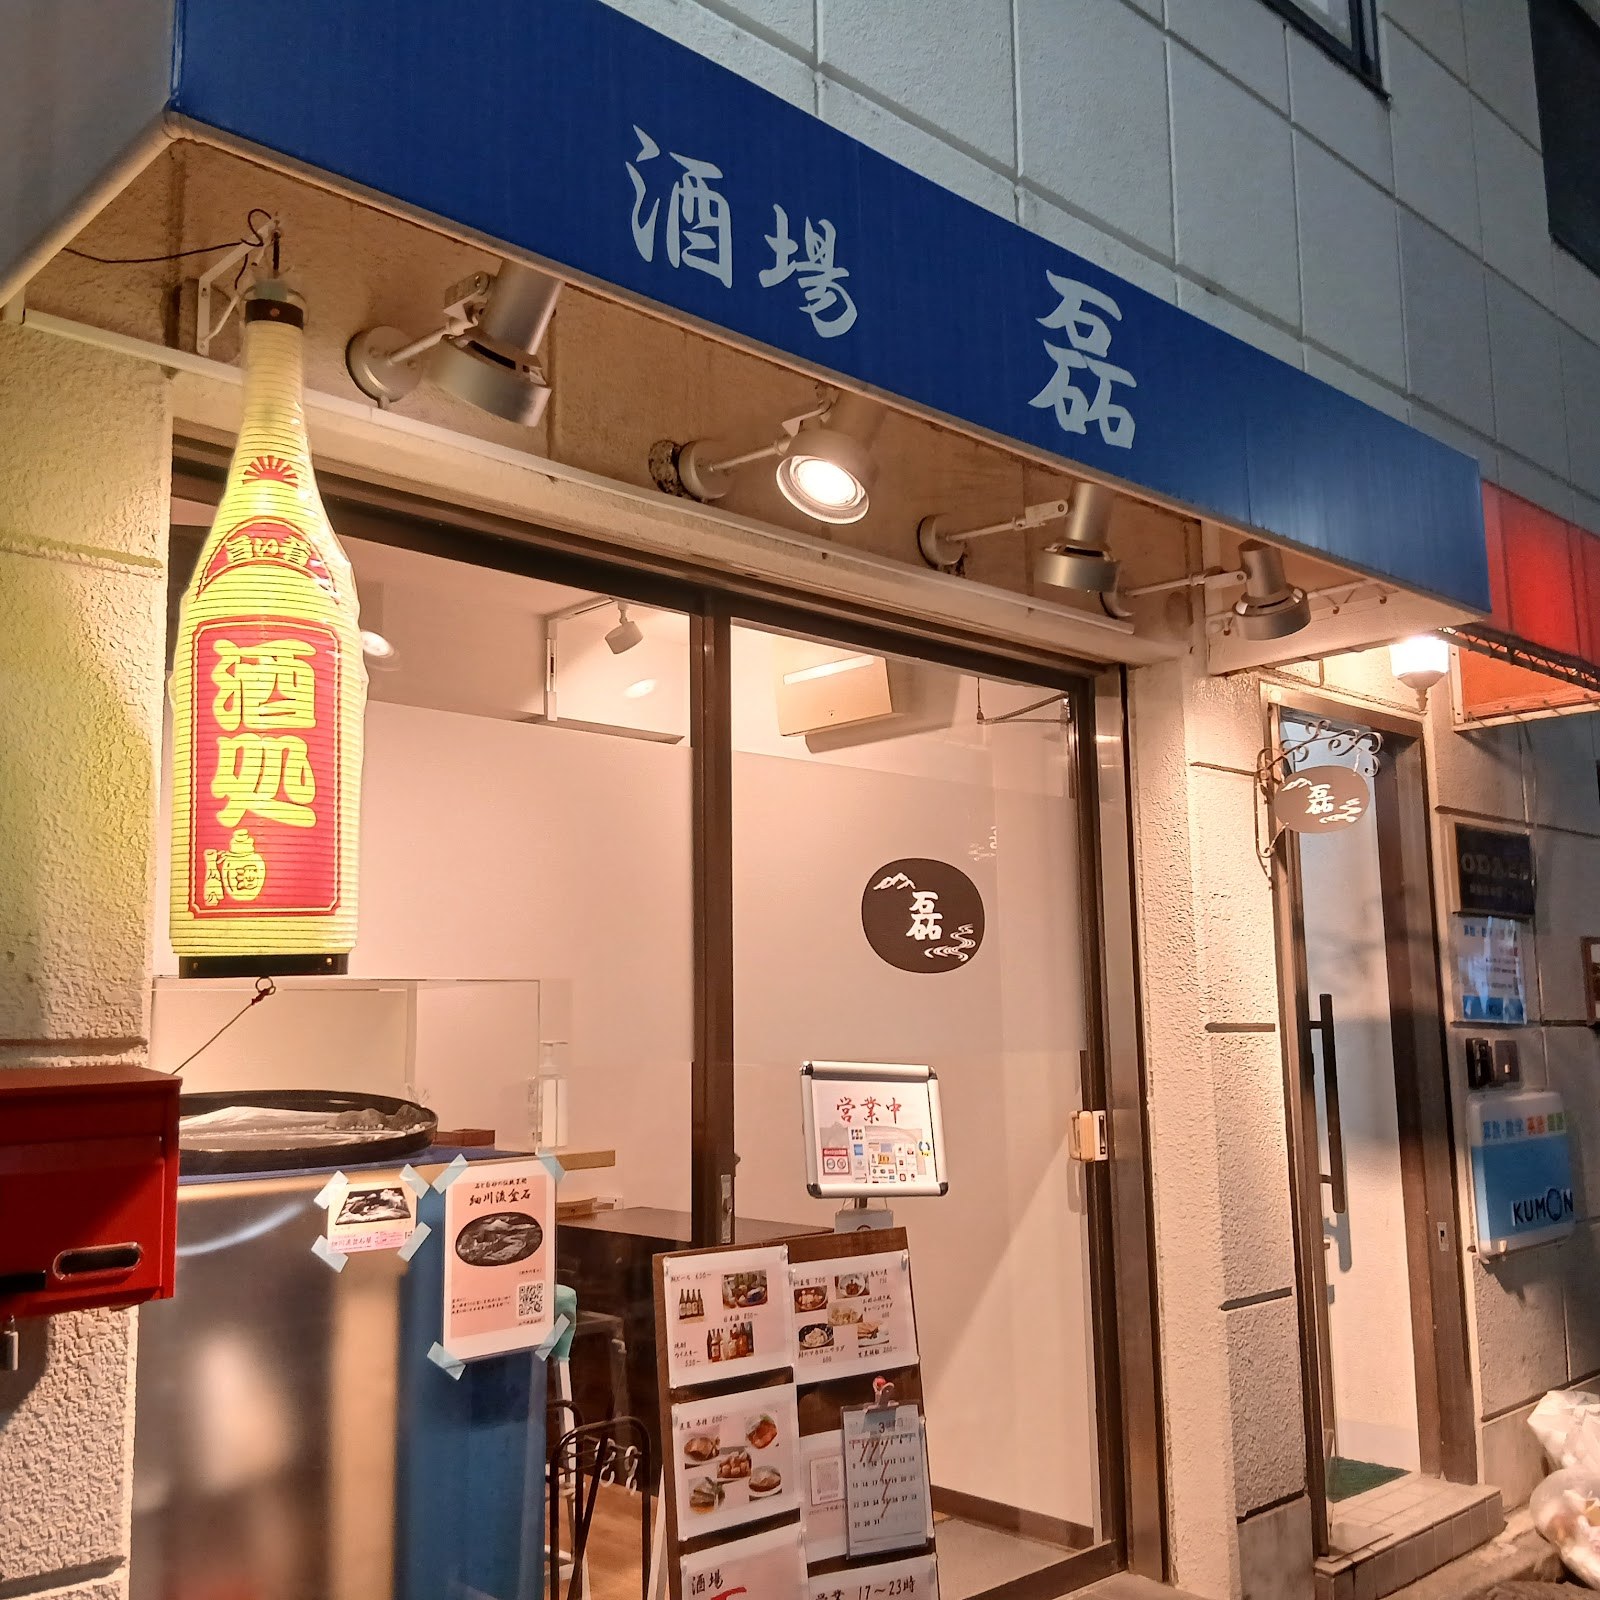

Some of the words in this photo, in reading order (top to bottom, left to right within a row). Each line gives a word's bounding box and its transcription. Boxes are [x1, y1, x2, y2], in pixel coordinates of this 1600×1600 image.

[625, 124, 857, 338] 酒場
[1028, 270, 1137, 450] 磊
[1305, 784, 1335, 815] 磊
[906, 891, 944, 941] 磊
[836, 1096, 902, 1124] 営業中
[1513, 1187, 1573, 1225] KUMON
[691, 1569, 724, 1596] 酒場
